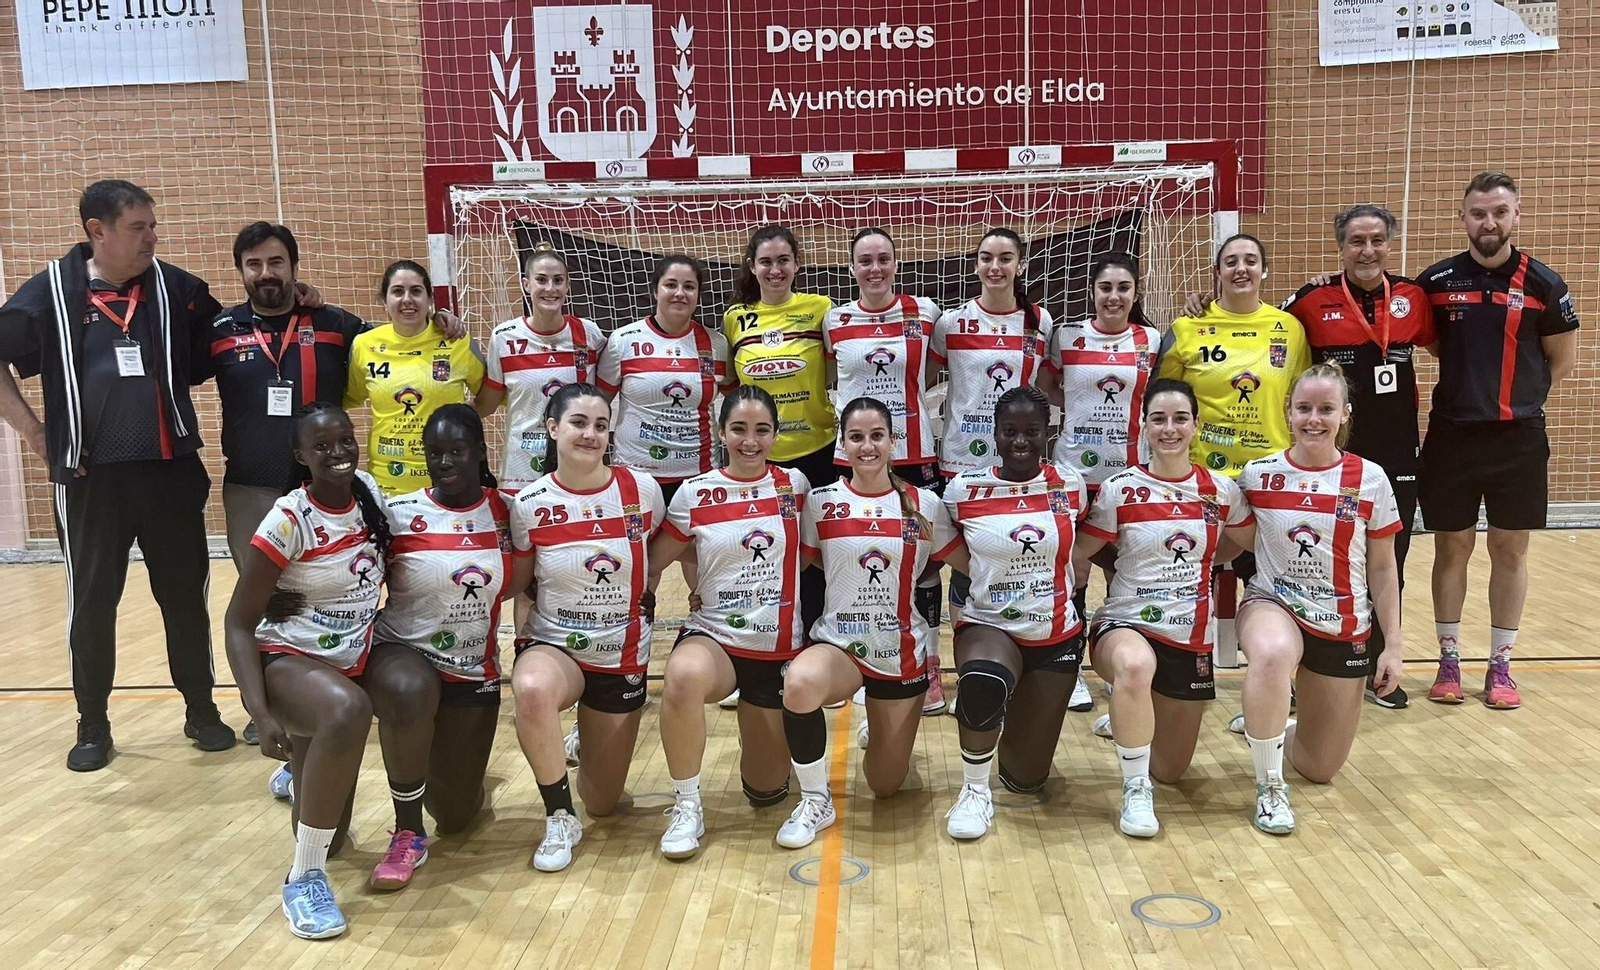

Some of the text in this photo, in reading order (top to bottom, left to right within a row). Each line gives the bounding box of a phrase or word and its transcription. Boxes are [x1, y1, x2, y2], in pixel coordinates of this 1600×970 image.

[1352, 5, 1361, 14] tú
[45, 18, 216, 33] think different
[766, 22, 935, 62] Deportes
[767, 77, 1105, 119] Ayuntamiento de Elda
[1448, 294, 1468, 302] G.N.
[736, 312, 759, 332] 12
[839, 312, 853, 326] 9
[1322, 311, 1345, 321] J.M.
[957, 318, 980, 334] 15
[506, 338, 529, 355] 17
[631, 341, 655, 357] 10
[1072, 336, 1087, 350] 4
[1198, 344, 1227, 363] 16
[366, 361, 391, 379] 14
[746, 360, 802, 374] MOYA
[772, 390, 810, 399] EUMÁTICOS
[963, 414, 993, 424] ROQUETAS
[522, 432, 548, 440] ROQUETA
[1073, 426, 1104, 436] ROQUETAS
[1202, 422, 1237, 437] ROQUETAS
[379, 436, 405, 447] ROQUETAS
[520, 440, 548, 451] DEMA
[410, 468, 430, 477] IKER
[1259, 472, 1286, 491] 18
[696, 486, 728, 507] 20
[965, 484, 996, 501] 77
[1121, 486, 1151, 505] 29
[534, 504, 569, 527] 25
[821, 501, 851, 520] 23
[409, 515, 428, 533] 6
[313, 525, 330, 546] 5
[988, 580, 1026, 593] ROQUETAS
[718, 589, 753, 601] ROQUETAS
[557, 607, 598, 621] ROQUETAS
[836, 612, 870, 622] ROQUETAS
